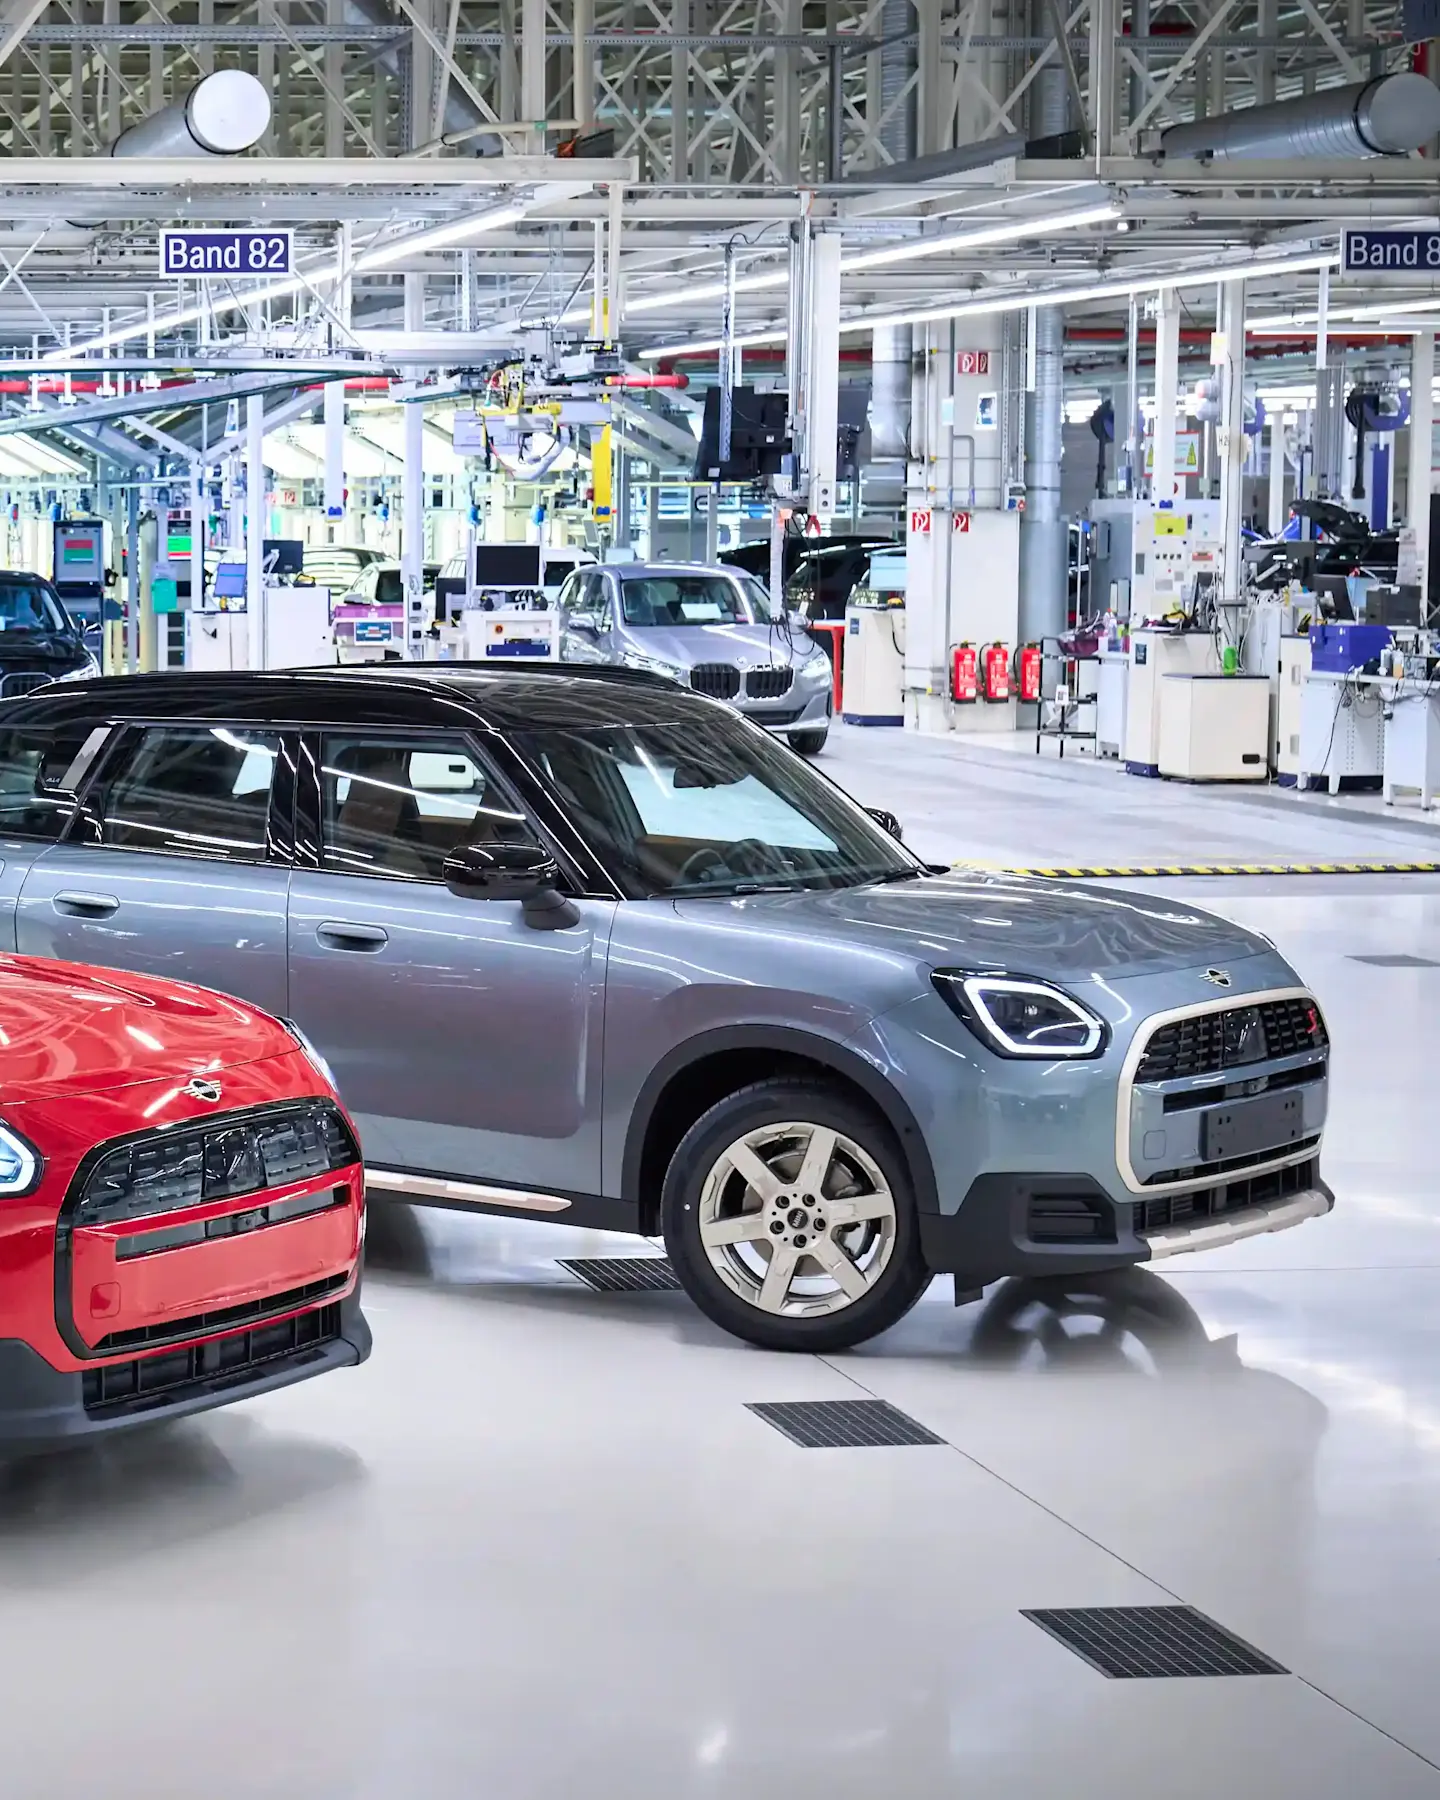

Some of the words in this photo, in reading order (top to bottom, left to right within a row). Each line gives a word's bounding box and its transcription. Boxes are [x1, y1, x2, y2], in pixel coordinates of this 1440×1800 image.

[168, 238, 240, 269] Band
[248, 238, 285, 269] 82
[1350, 235, 1418, 265] Band
